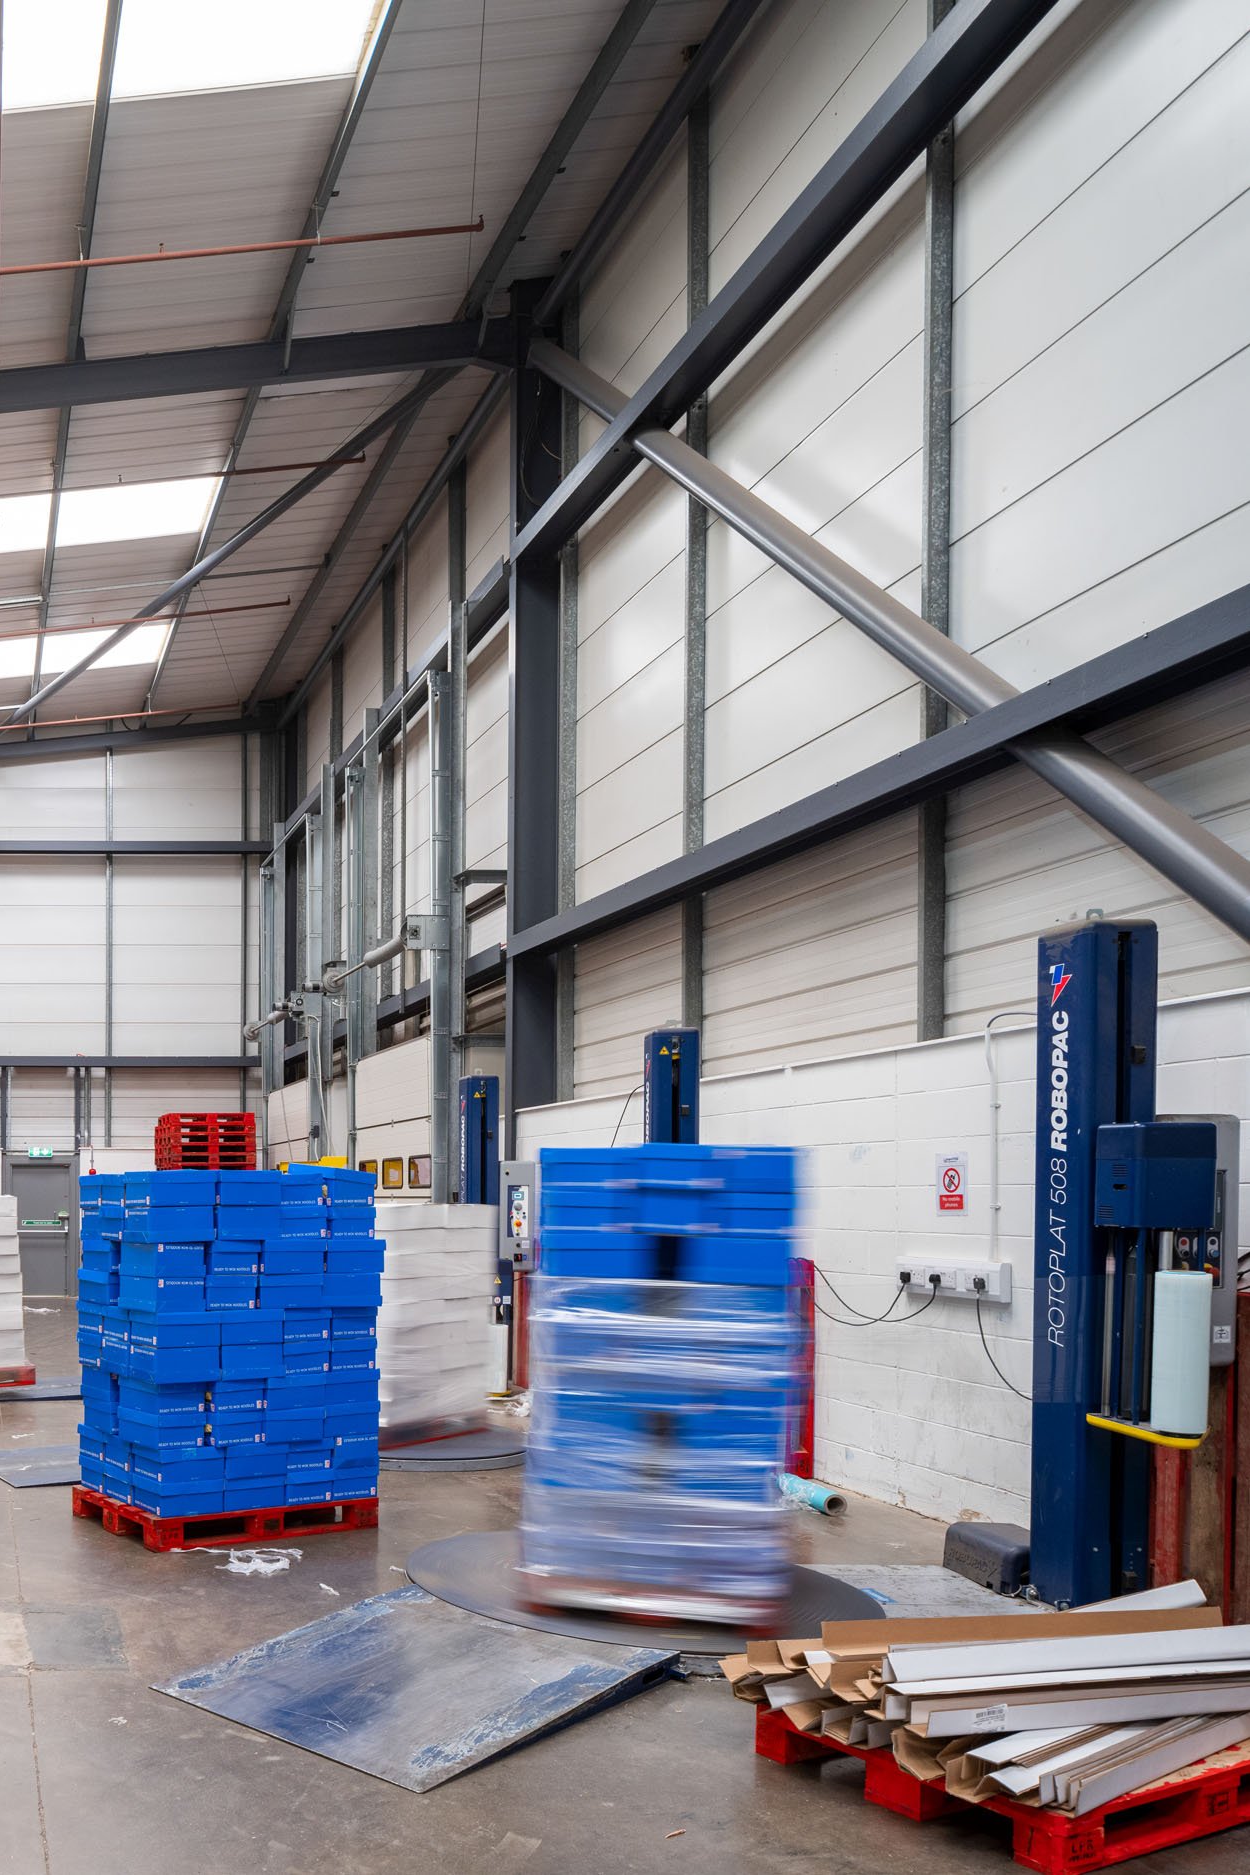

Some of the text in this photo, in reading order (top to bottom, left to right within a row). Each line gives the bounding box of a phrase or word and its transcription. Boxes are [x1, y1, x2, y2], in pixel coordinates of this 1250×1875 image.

[1048, 1010, 1069, 1347] ROTOPLAT 508 ROBOPAC
